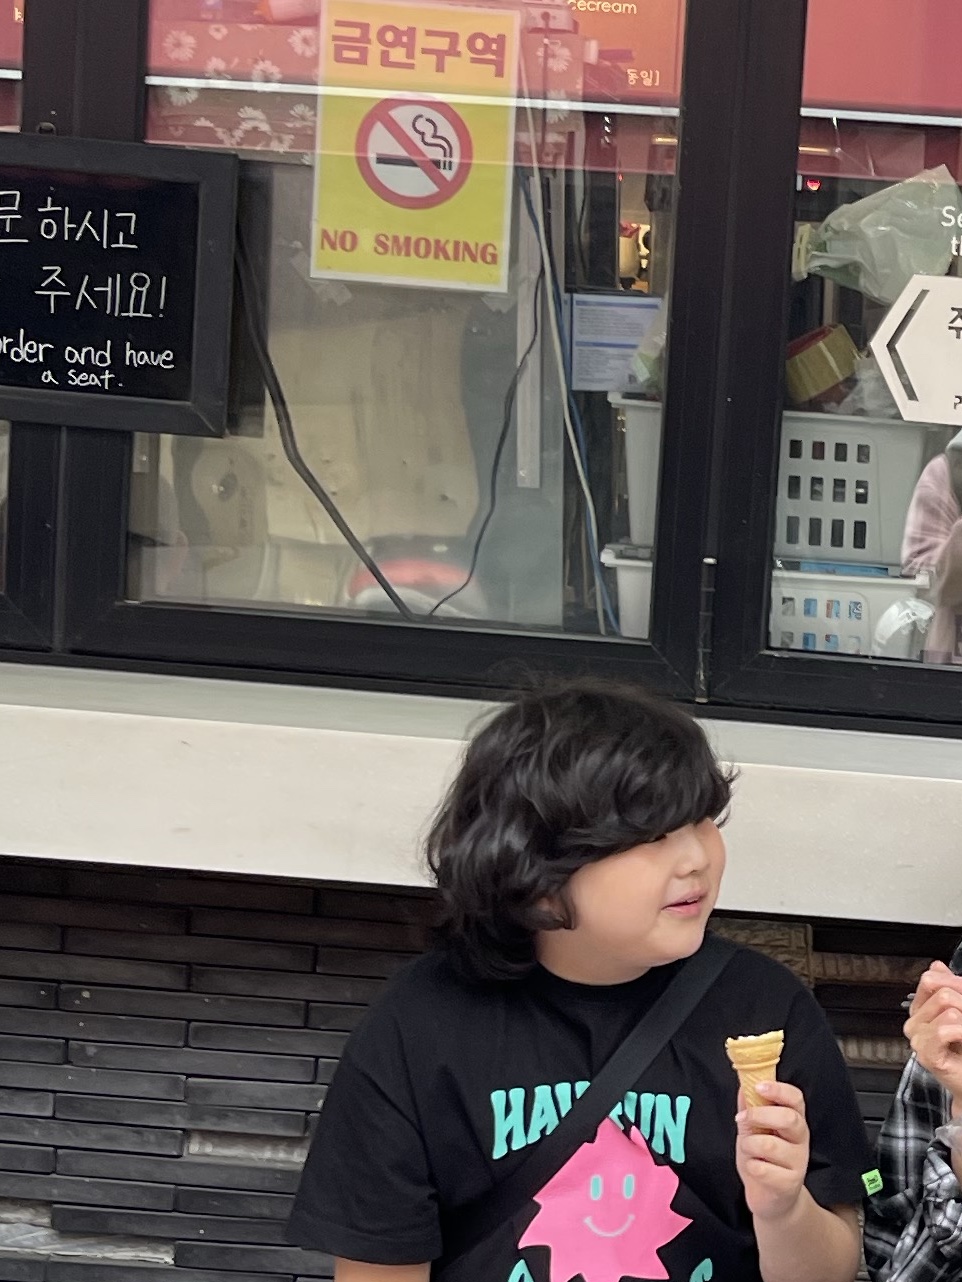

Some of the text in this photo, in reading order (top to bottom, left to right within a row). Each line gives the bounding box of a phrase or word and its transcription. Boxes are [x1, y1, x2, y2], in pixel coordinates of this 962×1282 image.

[332, 19, 506, 78] 금연구역
[37, 196, 139, 249] 하시고
[320, 229, 499, 265] NO SMOKING
[34, 265, 167, 318] 주세요!
[0, 328, 174, 369] rder and have
[41, 369, 123, 390] a seat.
[491, 1081, 591, 1160] HA
